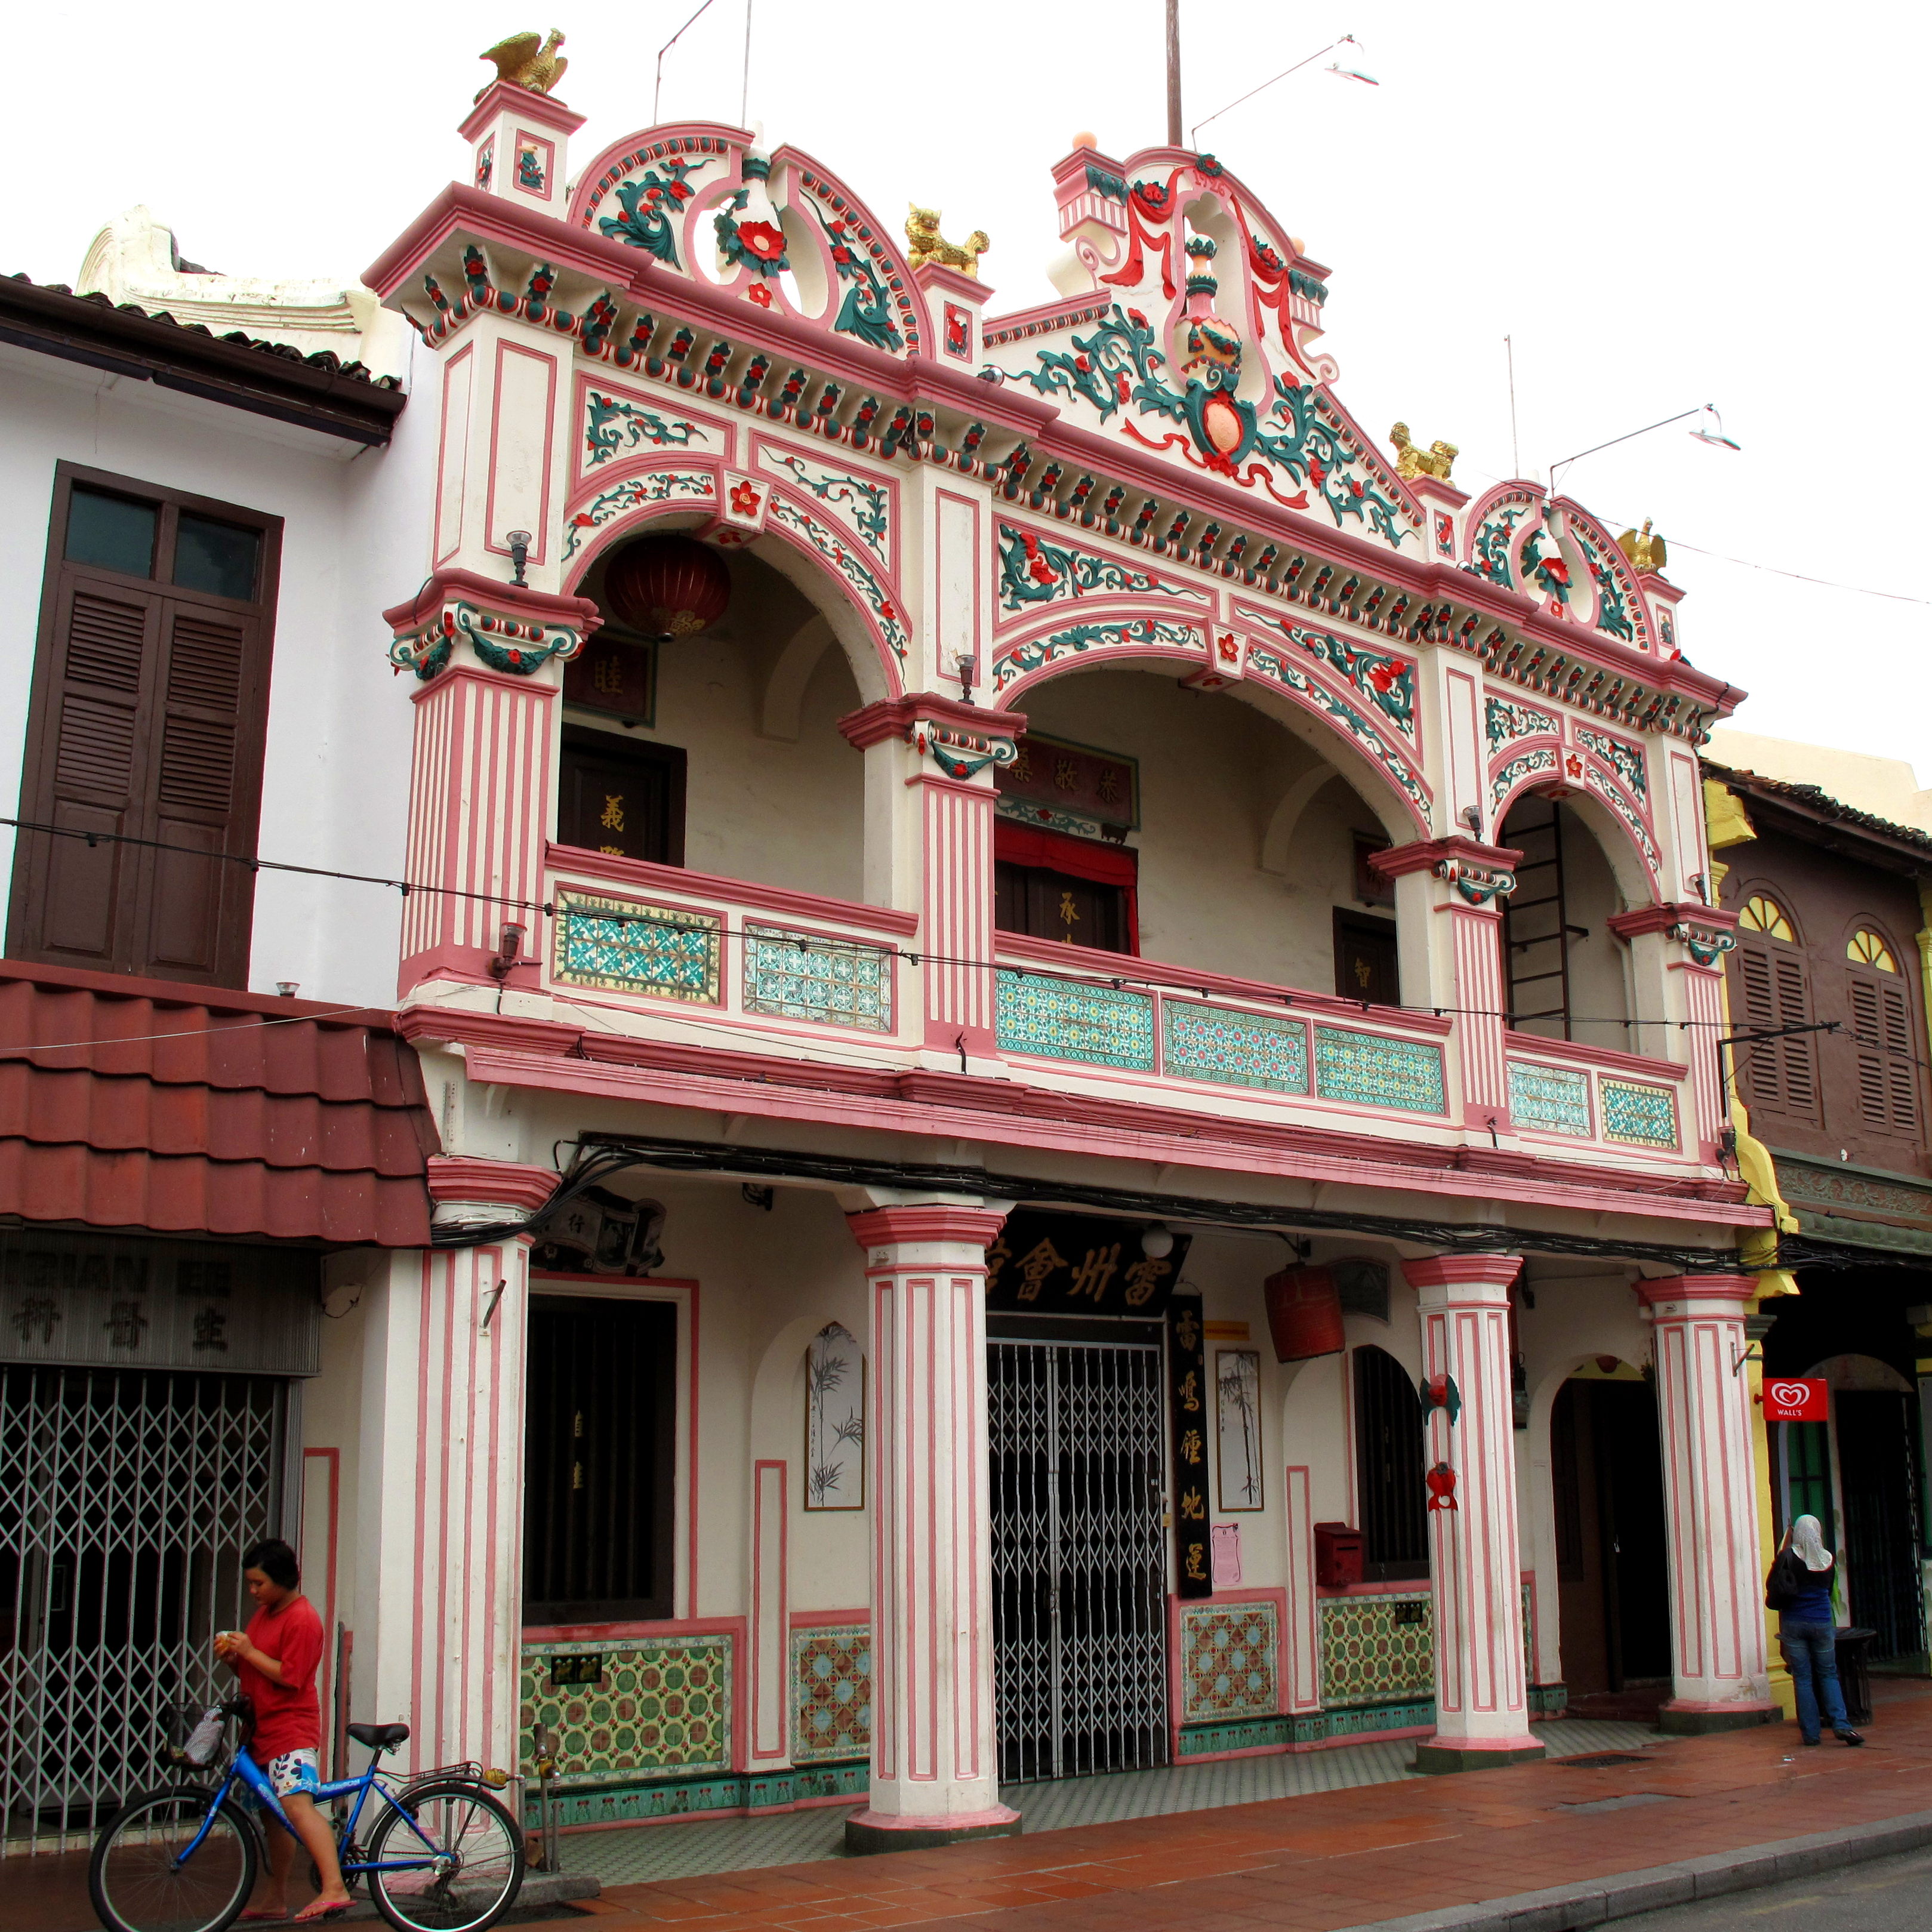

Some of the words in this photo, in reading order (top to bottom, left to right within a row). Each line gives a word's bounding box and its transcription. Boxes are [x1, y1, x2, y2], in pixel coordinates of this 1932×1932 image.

[1193, 170, 1225, 197] 1926
[593, 655, 624, 695] 睦
[599, 794, 625, 856] 義
